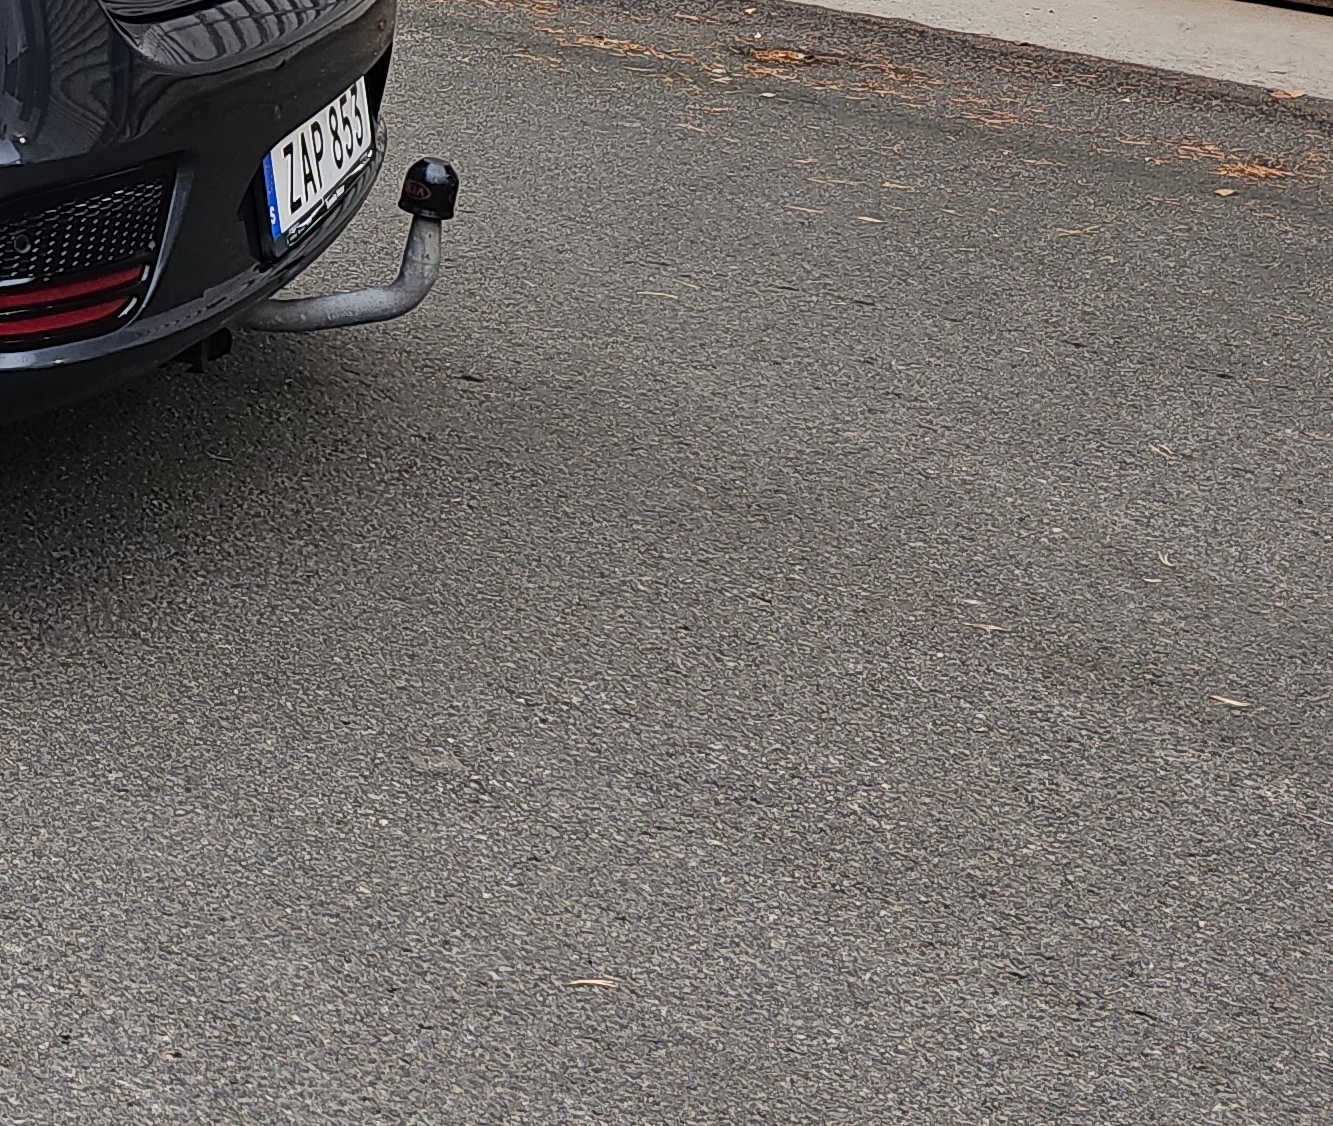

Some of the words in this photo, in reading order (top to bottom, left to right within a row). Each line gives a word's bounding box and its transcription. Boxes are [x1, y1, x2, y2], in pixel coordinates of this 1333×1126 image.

[281, 120, 324, 215] ZAP
[328, 82, 364, 170] 853
[269, 205, 276, 225] S
